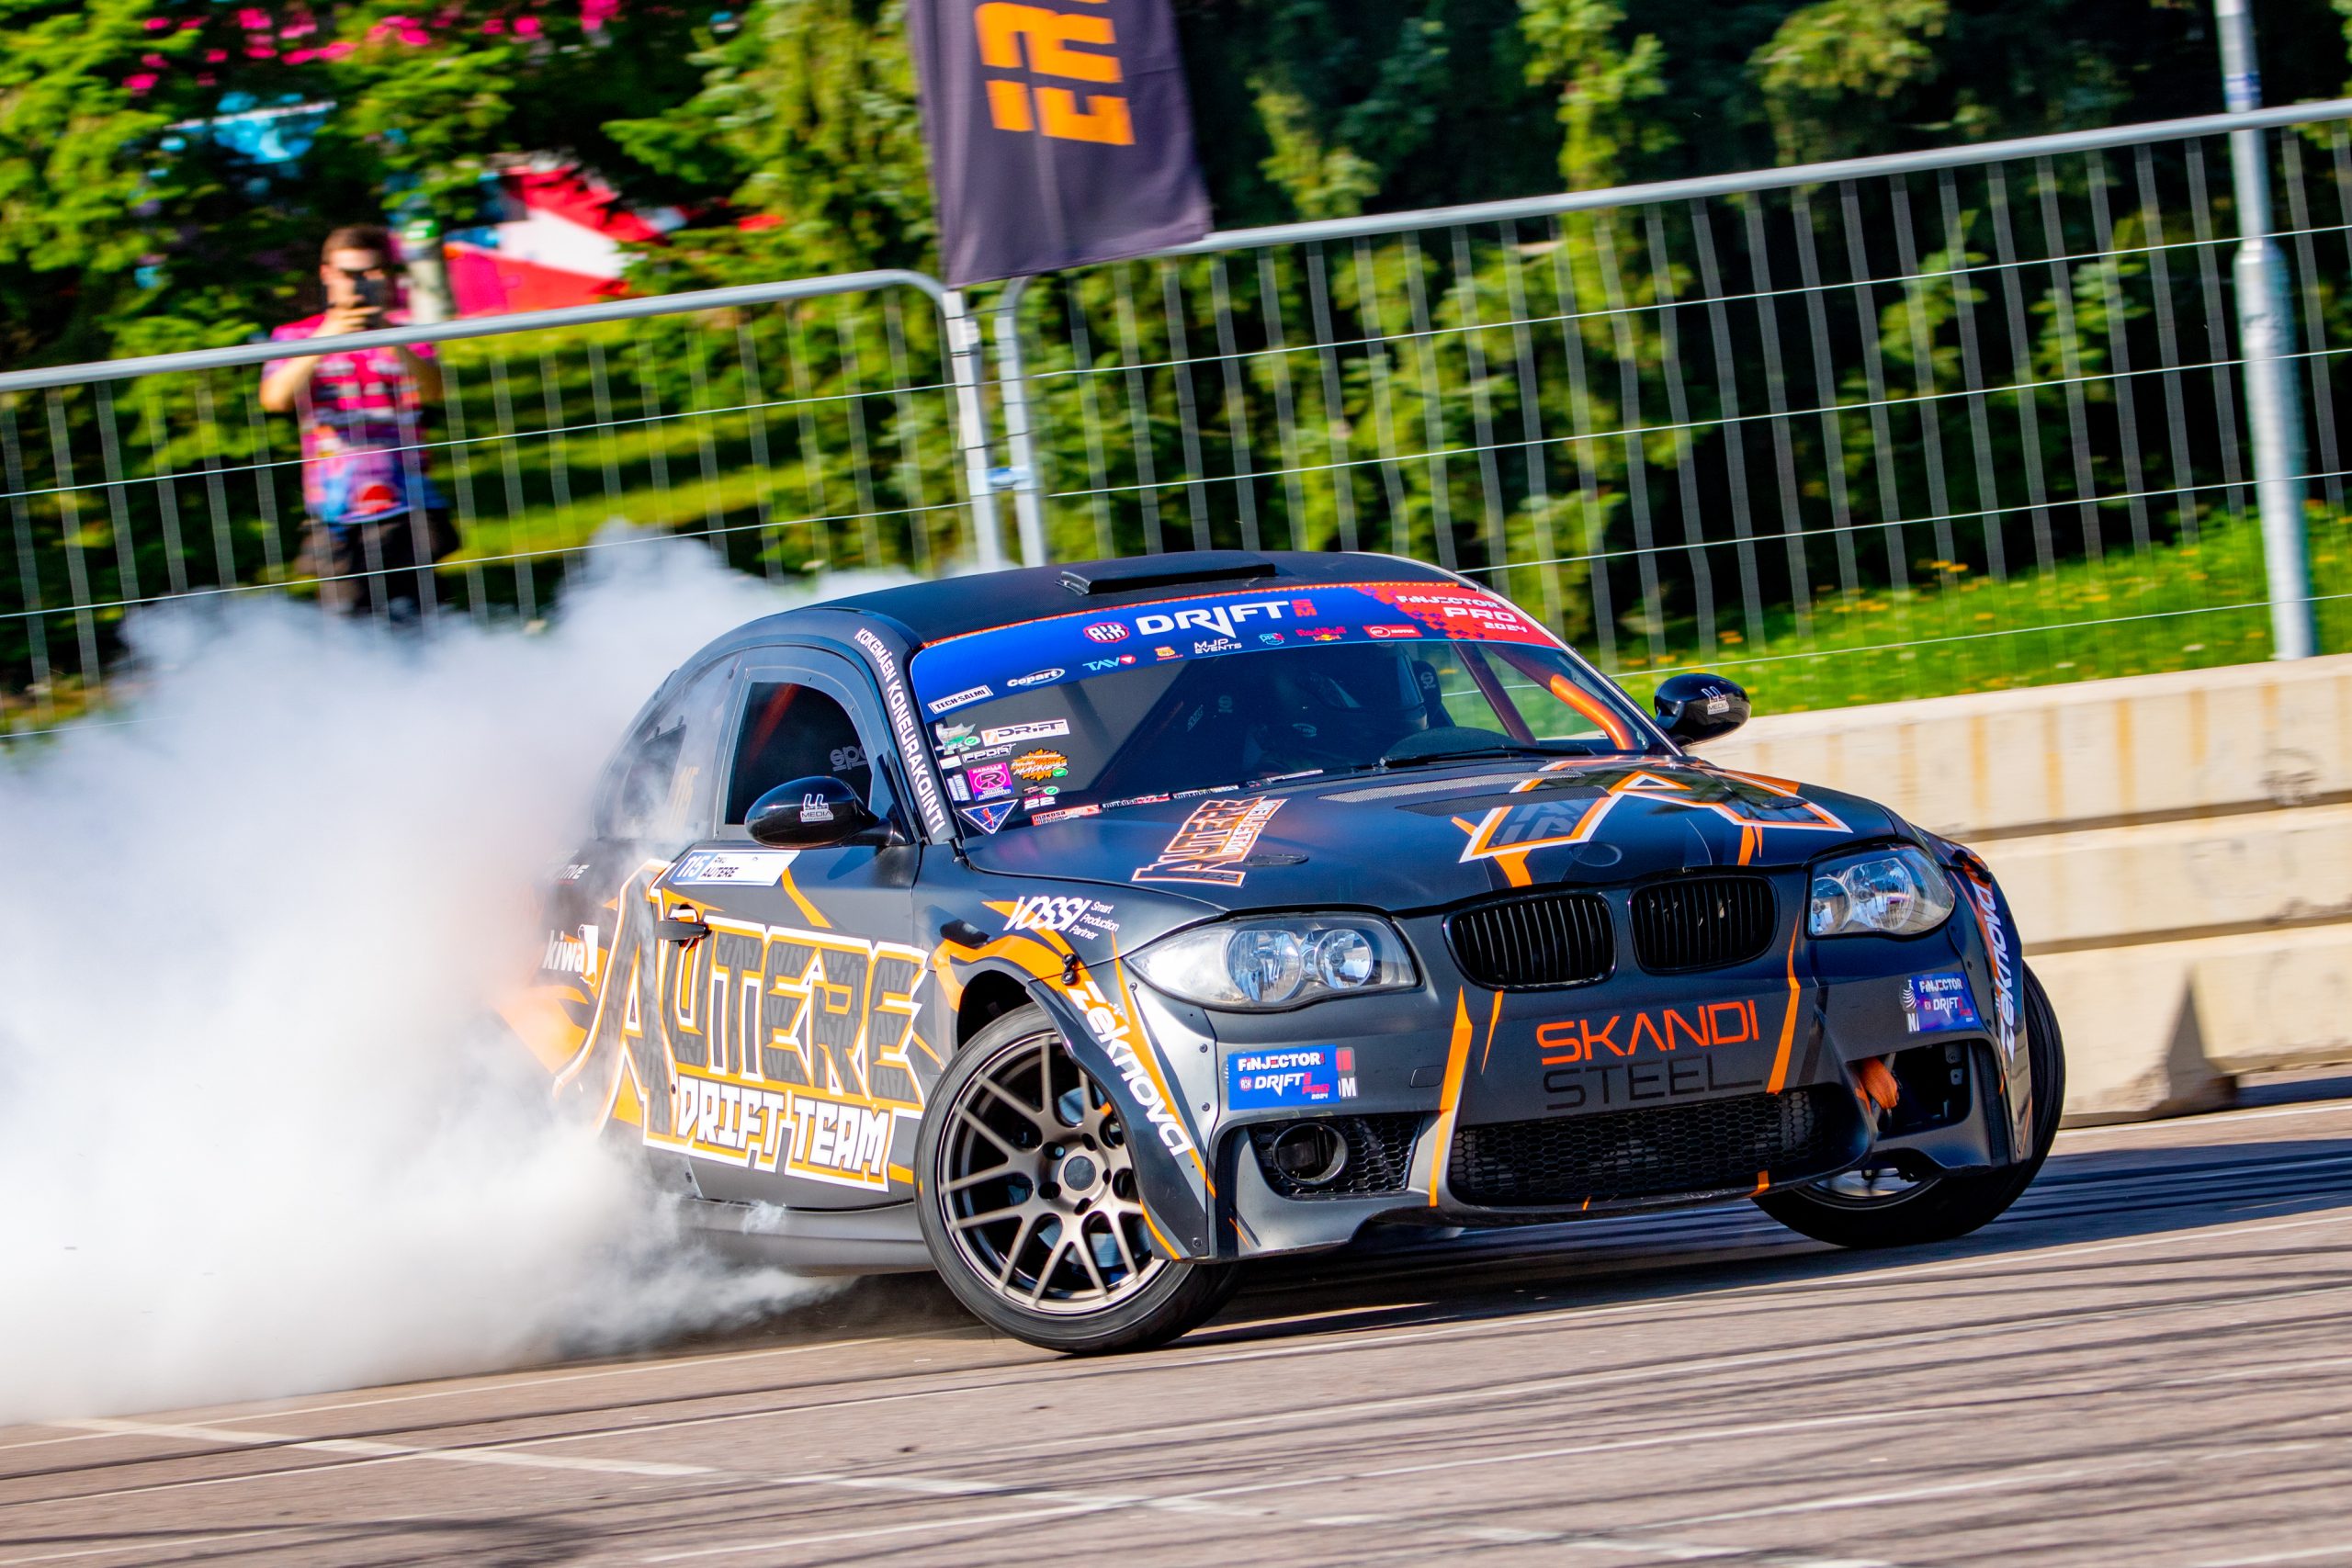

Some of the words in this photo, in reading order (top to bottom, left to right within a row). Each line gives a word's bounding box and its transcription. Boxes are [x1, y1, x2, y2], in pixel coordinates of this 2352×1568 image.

[974, 0, 1136, 145] ER
[1136, 601, 1289, 638] DRIFT
[1443, 607, 1517, 623] PRO
[1483, 622, 1528, 633] 2024
[1194, 643, 1242, 654] EVENTS
[1006, 669, 1059, 687] Copart
[934, 689, 987, 710] TECH-SALMI
[887, 680, 946, 835] KONEURAKOINTI
[1024, 796, 1056, 809] 22
[801, 810, 832, 818] MEDIA
[676, 855, 711, 878] 115
[700, 866, 739, 878] AUTERE
[1002, 896, 1092, 931] VOSSI
[1091, 901, 1114, 915] Smart
[1080, 913, 1120, 932] Production
[1069, 924, 1099, 940] Partner
[542, 929, 585, 973] kiwa
[1933, 997, 1959, 1019] DRIFT
[1535, 998, 1760, 1066] SKANDI
[1254, 1073, 1305, 1097] DRIFT
[1542, 1053, 1763, 1111] STEEL
[676, 1075, 786, 1155] DRIFT
[792, 1097, 891, 1176] TEAM
